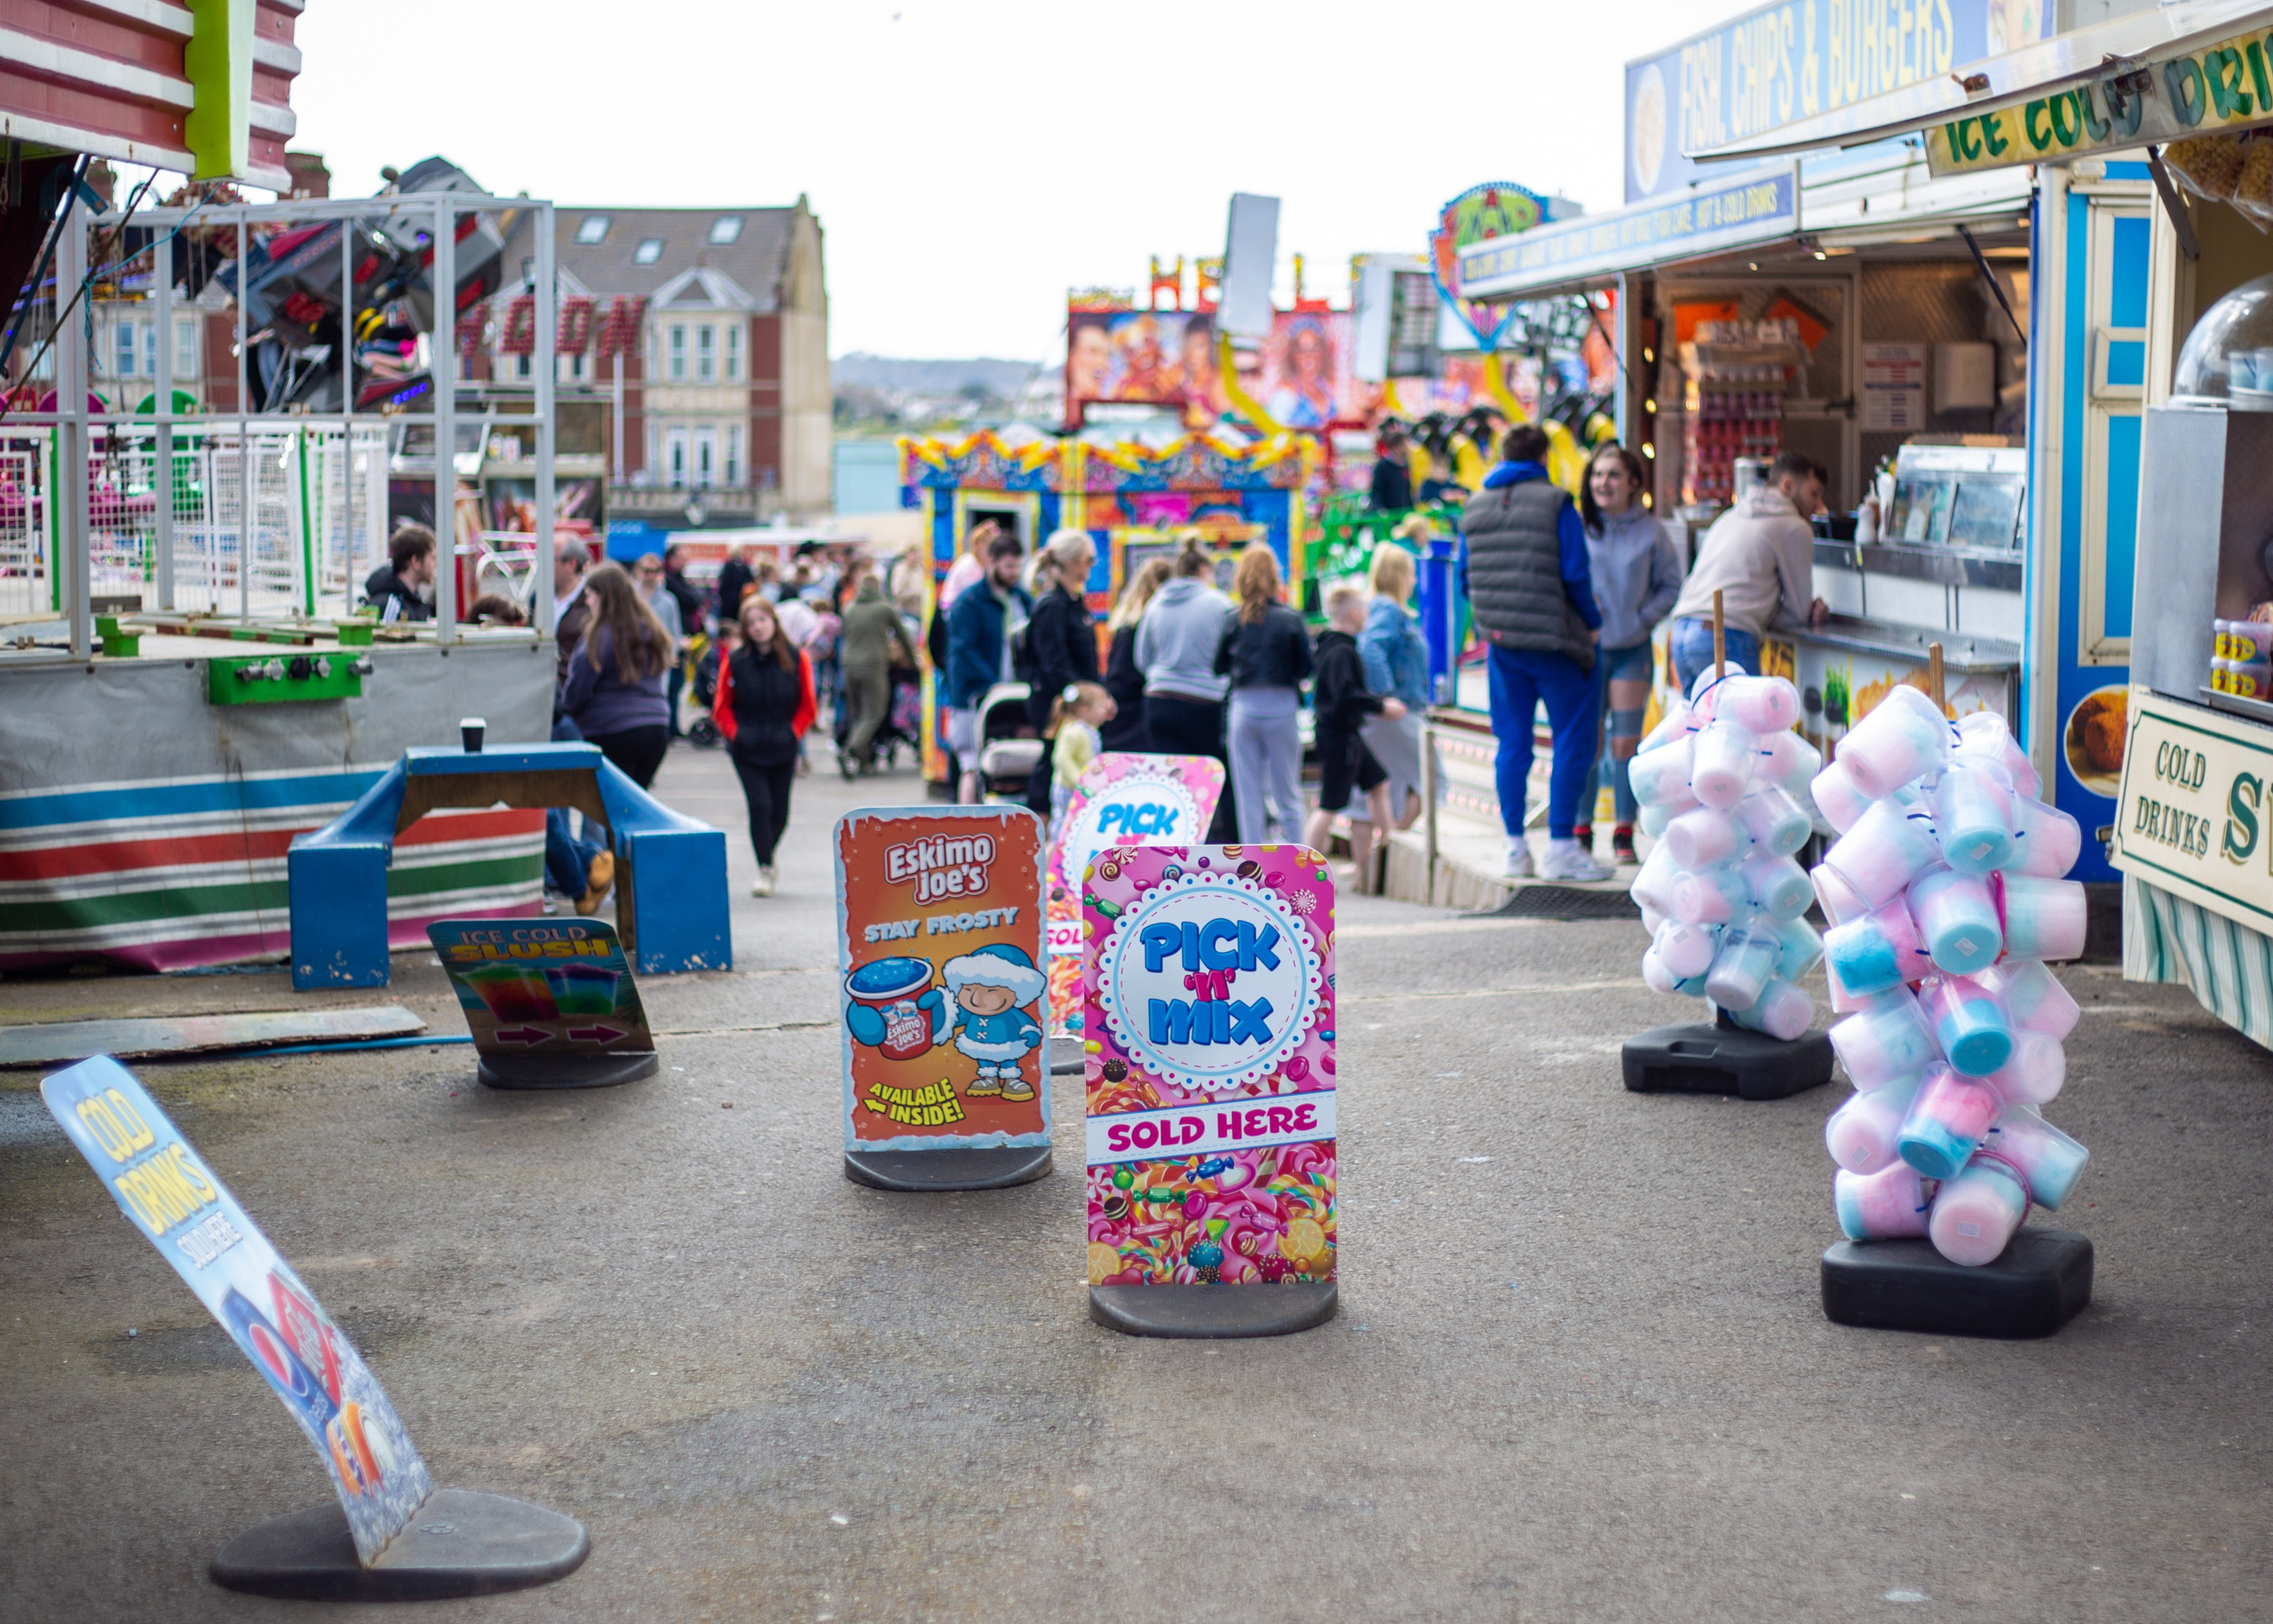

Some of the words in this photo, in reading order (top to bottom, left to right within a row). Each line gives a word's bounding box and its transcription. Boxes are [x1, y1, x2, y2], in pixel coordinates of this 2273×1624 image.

[1731, 6, 1794, 138] CHIPS
[1802, 0, 1820, 116] &
[1830, 0, 1953, 110] BURGERS
[1944, 111, 2008, 163] ICE
[2025, 78, 2142, 151] COLD
[1746, 181, 1778, 219] DRINKS
[2156, 740, 2206, 789] COLD
[1097, 803, 1179, 836] PICK
[2136, 796, 2211, 858] DRINKS
[889, 837, 992, 880] Eskimo
[459, 929, 505, 946] ICE
[511, 926, 588, 944] COLD
[864, 919, 922, 943] STAY
[927, 907, 1019, 935] FROSTY
[1048, 928, 1082, 946] SOL
[1140, 918, 1281, 973] PICK
[449, 939, 613, 963] SLUSH
[888, 1018, 921, 1040] Eskimo
[1148, 996, 1274, 1046] MIX
[868, 1077, 956, 1107] AVAILABLE
[889, 1098, 966, 1126] INSIDE!
[75, 1086, 157, 1166] COLD
[1107, 1116, 1205, 1153] SOLD
[1217, 1103, 1318, 1140] HERE
[113, 1141, 219, 1239] DRINKS
